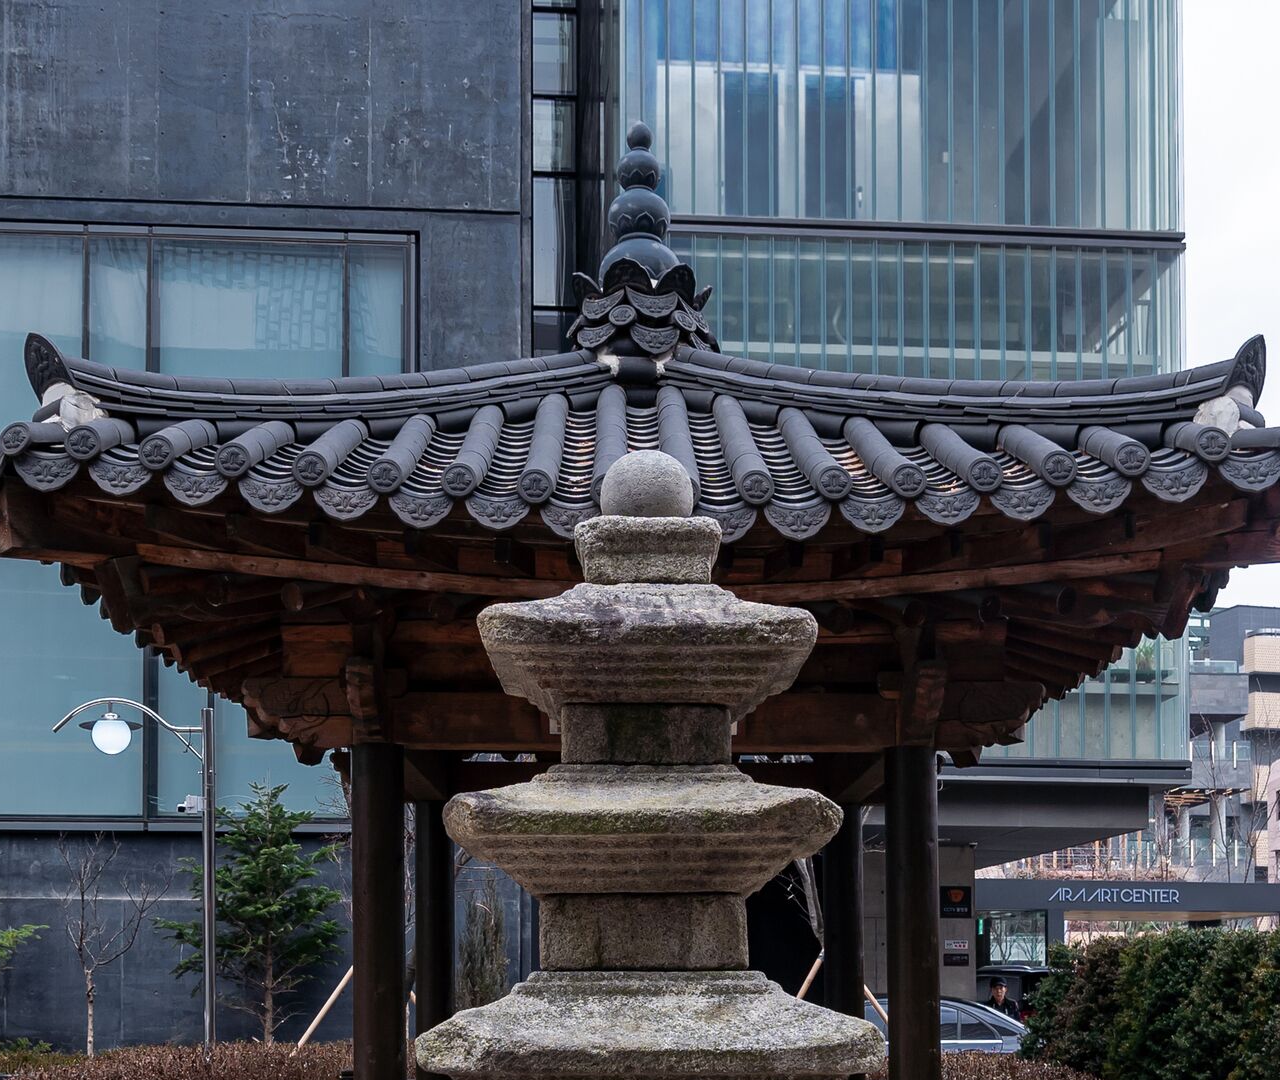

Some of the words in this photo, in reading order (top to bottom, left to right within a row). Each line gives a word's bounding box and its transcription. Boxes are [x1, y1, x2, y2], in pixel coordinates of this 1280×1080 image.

[1048, 887, 1086, 902] ARA
[1087, 887, 1120, 903] ART
[1120, 888, 1180, 903] CENTER
